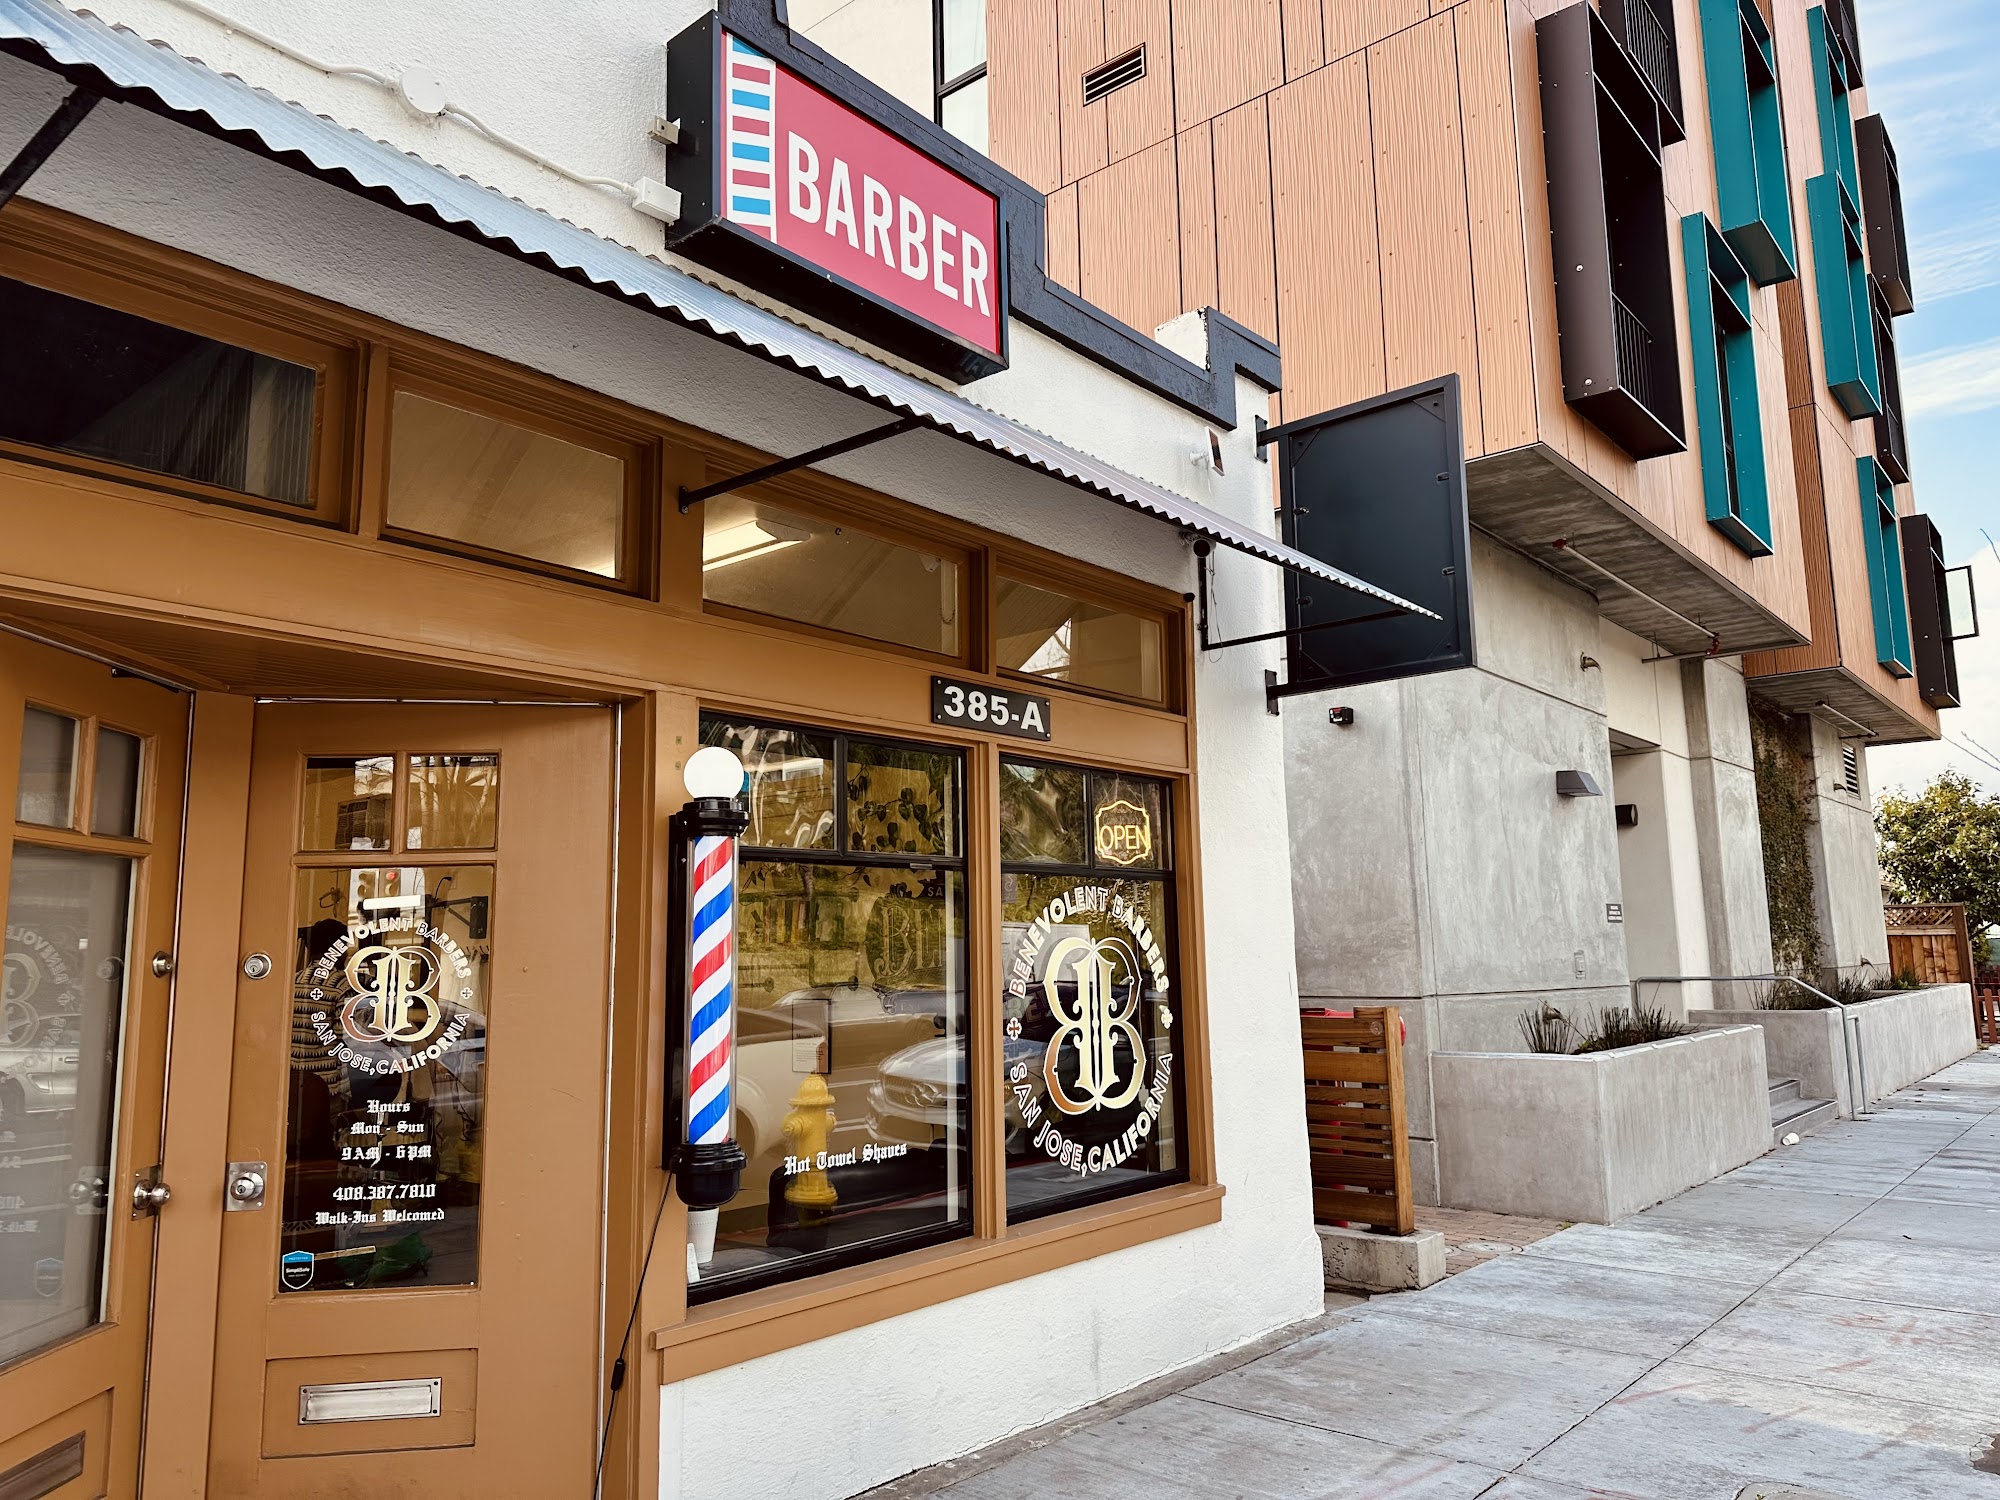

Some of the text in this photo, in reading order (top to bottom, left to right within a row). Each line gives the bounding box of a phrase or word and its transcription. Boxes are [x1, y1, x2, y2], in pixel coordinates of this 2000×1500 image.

[788, 130, 991, 318] BARBER
[943, 685, 1045, 733] 385-A
[1100, 825, 1150, 850] OPEN
[313, 917, 472, 980] BENEVOLENT BARBERS
[1008, 885, 1170, 999] BENEVOLENT BARBERS
[310, 1011, 338, 1047] SAN
[375, 1012, 471, 1075] CALIFORNIA
[366, 1099, 411, 1114] Hours
[1009, 1062, 1043, 1129] SAN
[1087, 1052, 1173, 1173] CALIFORNIA
[350, 1121, 381, 1135] Mon
[396, 1120, 425, 1134] Sun
[783, 1142, 908, 1176] Hot Towel Shaves
[332, 1183, 437, 1201] 408.387.7810
[315, 1208, 445, 1225] Walk-Ins Welcomed
